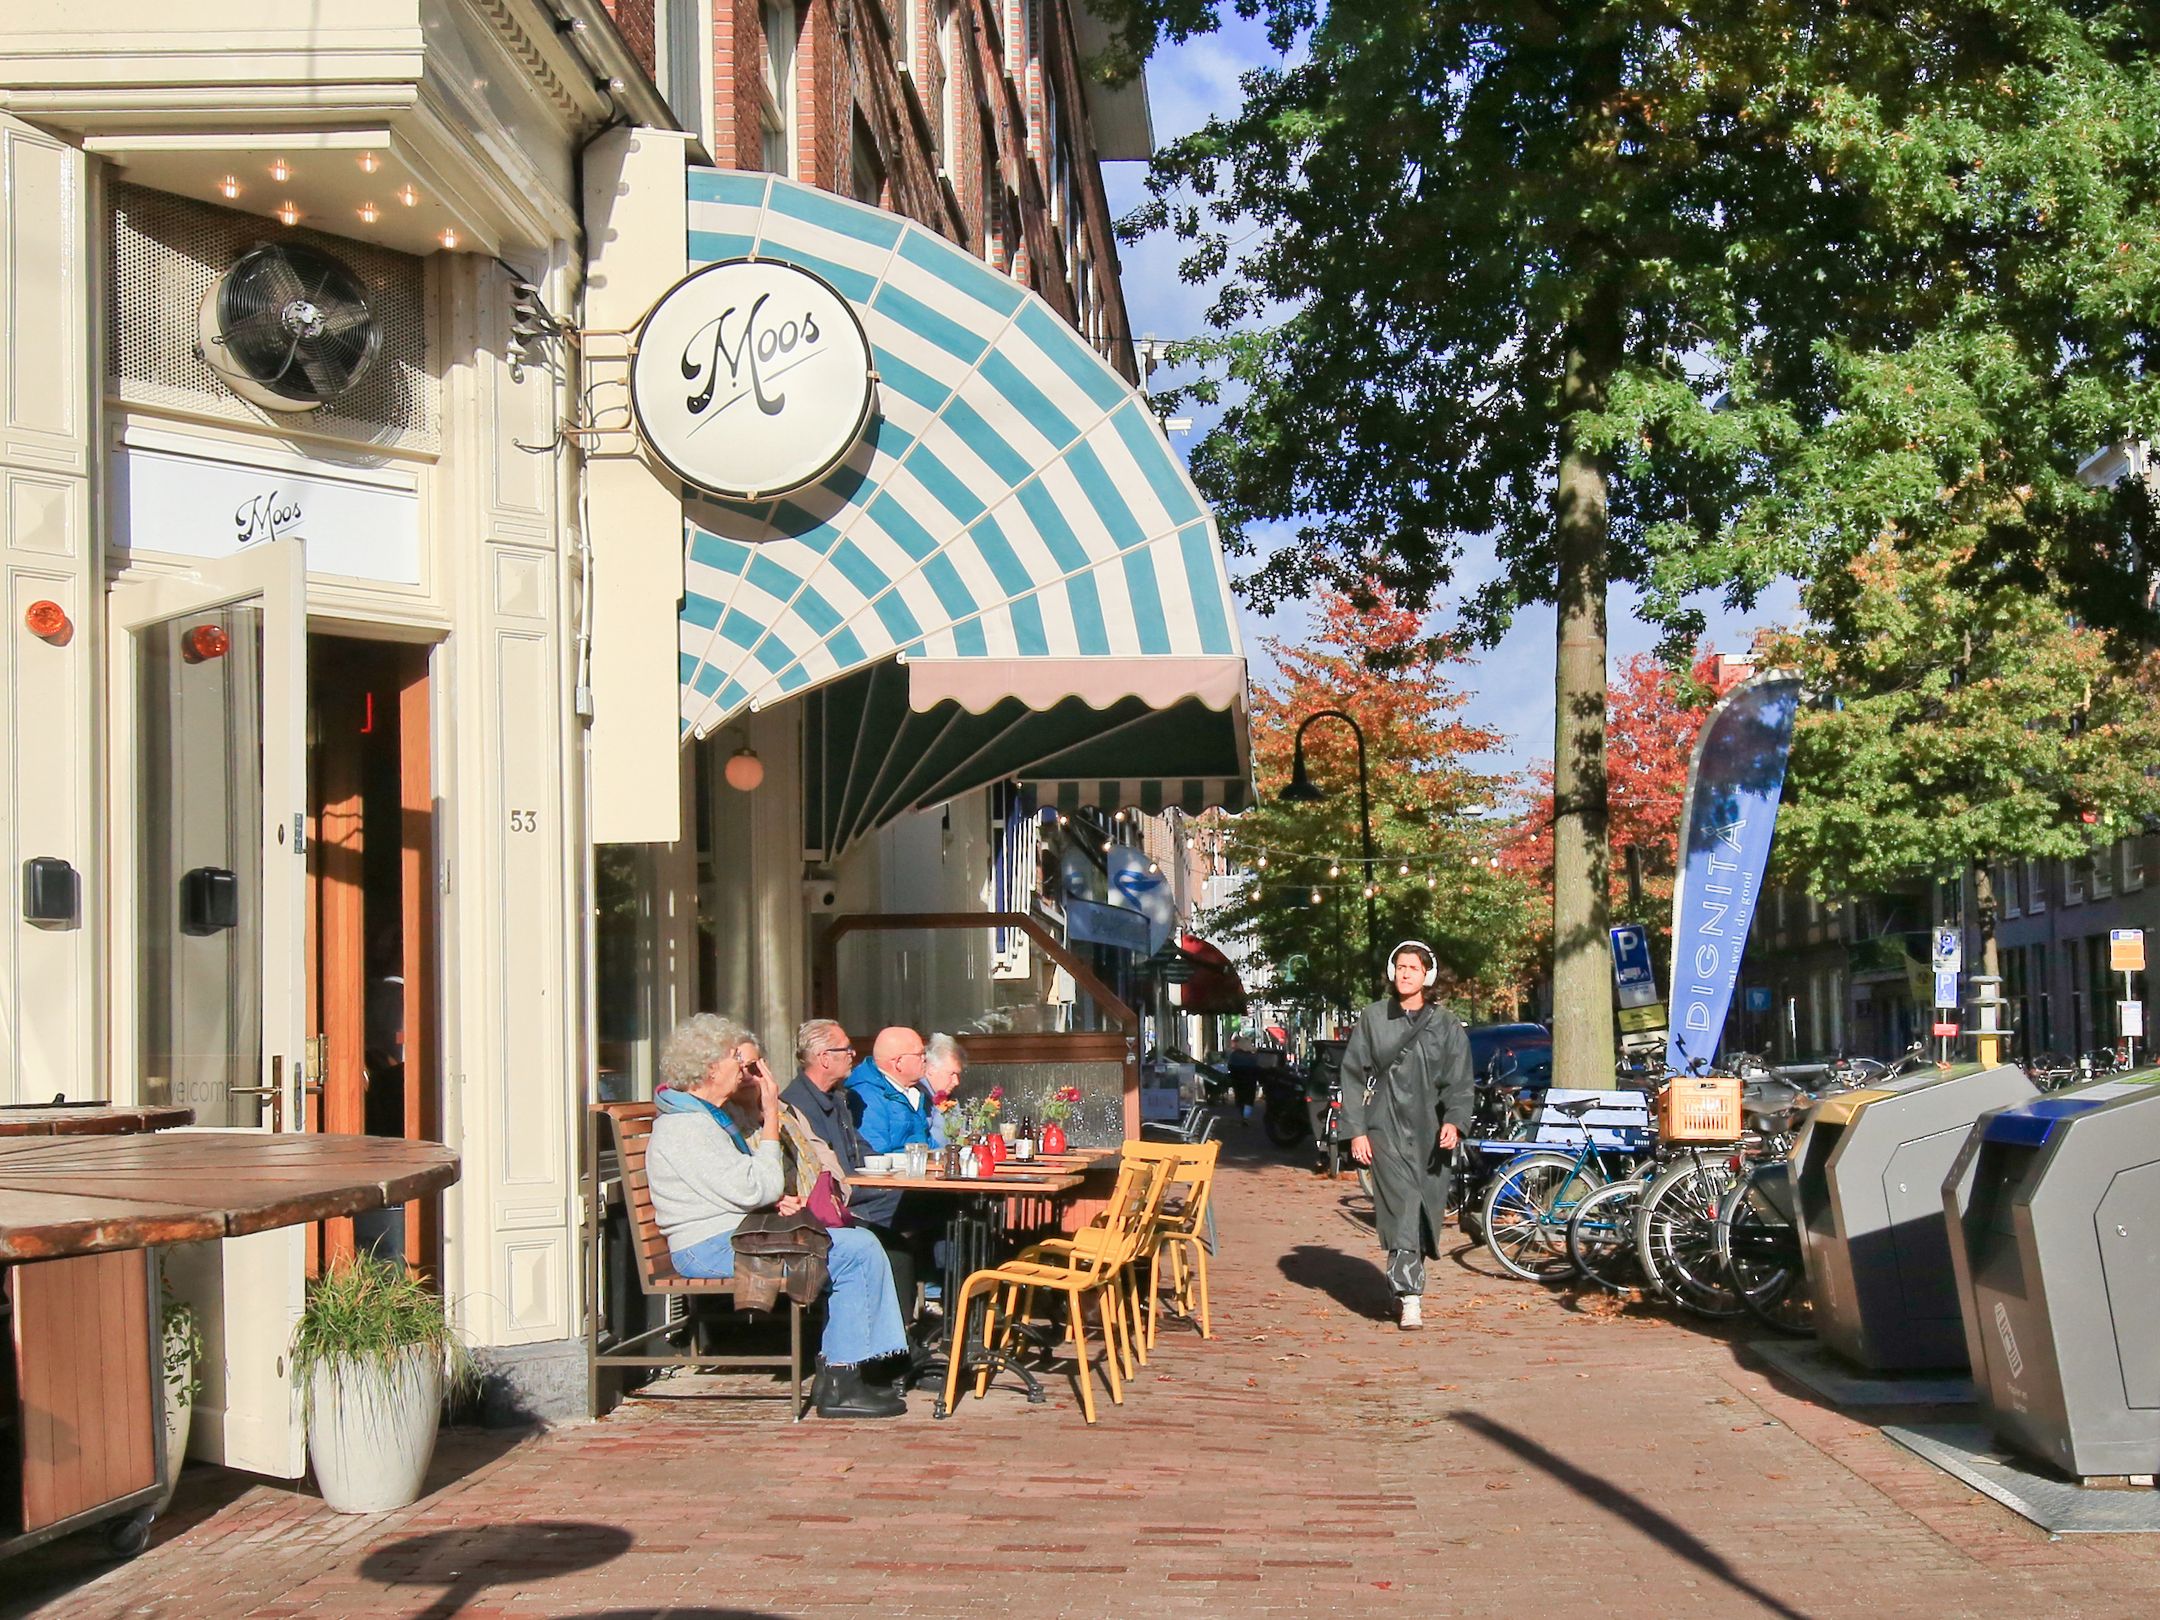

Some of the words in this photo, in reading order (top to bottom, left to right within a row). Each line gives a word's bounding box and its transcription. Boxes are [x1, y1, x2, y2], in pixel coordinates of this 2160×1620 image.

[681, 292, 821, 416] Moos
[235, 490, 302, 542] Moos
[510, 809, 537, 833] 53
[1740, 871, 1753, 906] good
[1734, 910, 1747, 927] do
[1617, 931, 1639, 962] P
[1731, 932, 1744, 964] well,
[1940, 974, 1953, 991] P
[161, 1076, 234, 1103] welcome
